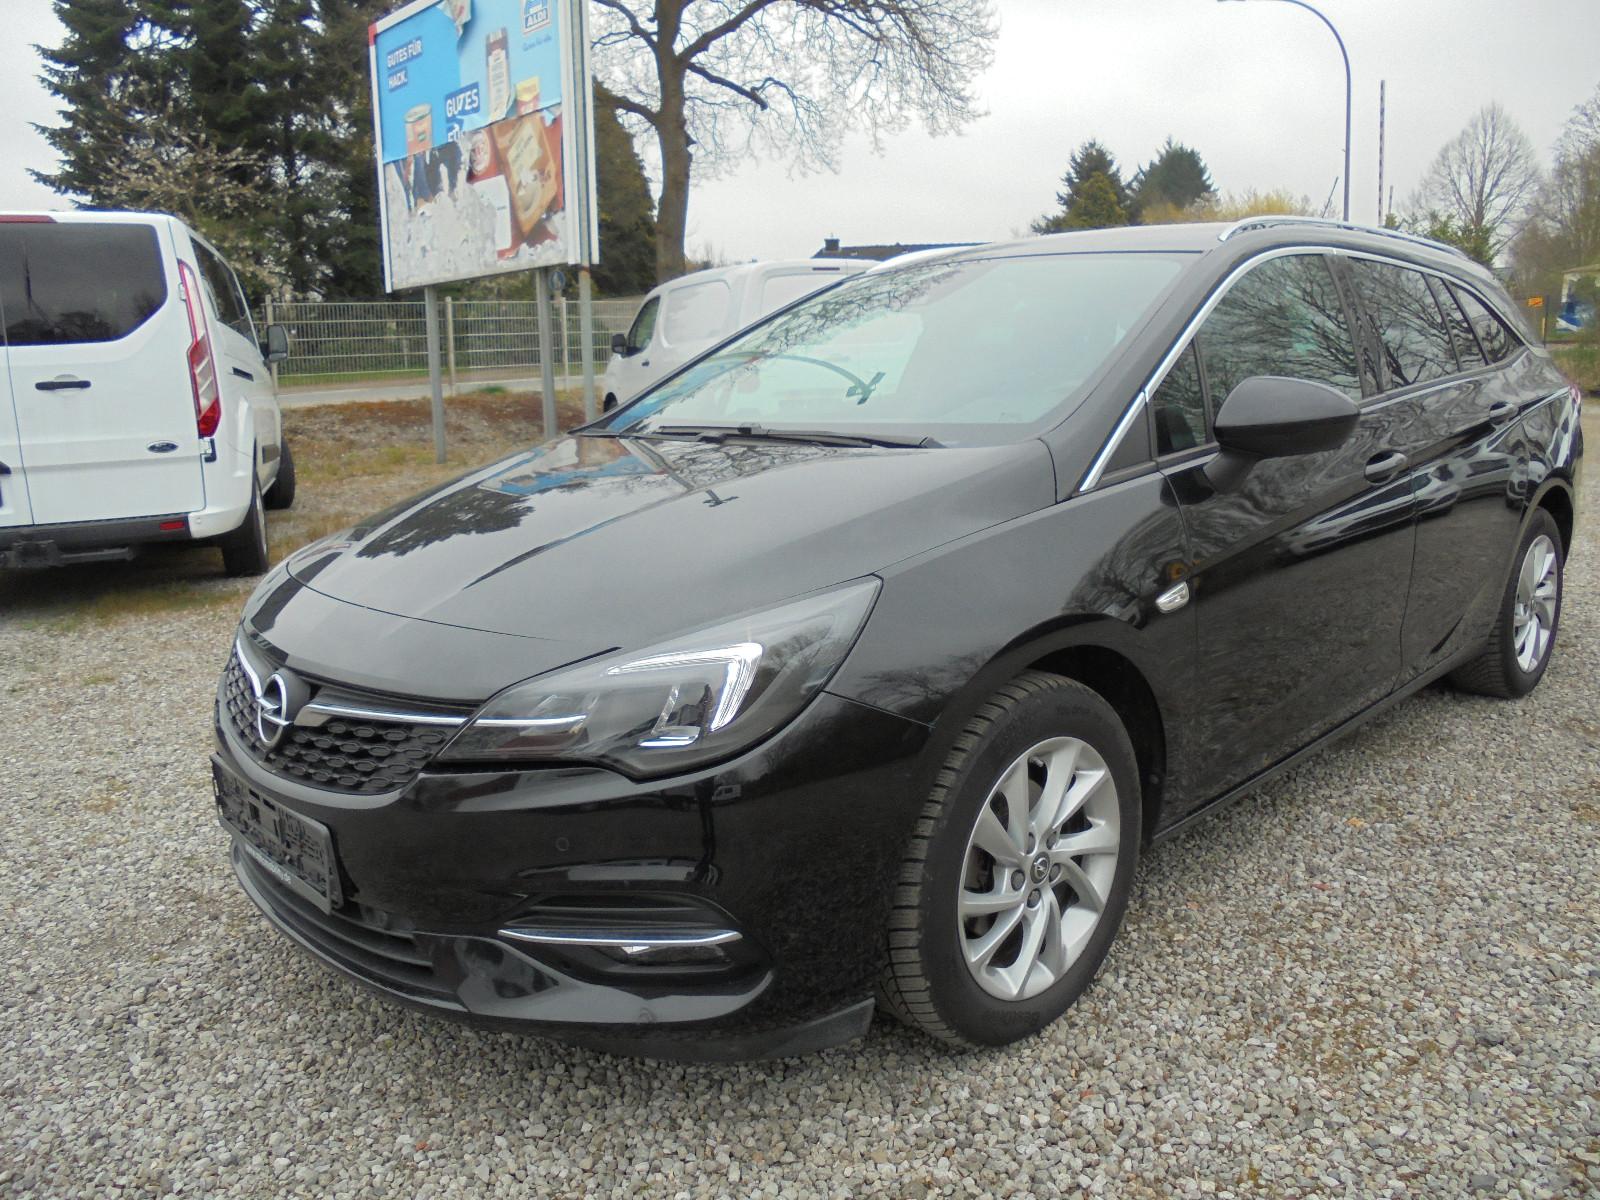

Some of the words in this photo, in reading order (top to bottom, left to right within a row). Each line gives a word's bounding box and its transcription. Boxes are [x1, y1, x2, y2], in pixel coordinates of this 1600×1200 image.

[527, 9, 548, 28] ALDI
[387, 47, 408, 68] GUTES
[446, 88, 479, 118] GUTES
